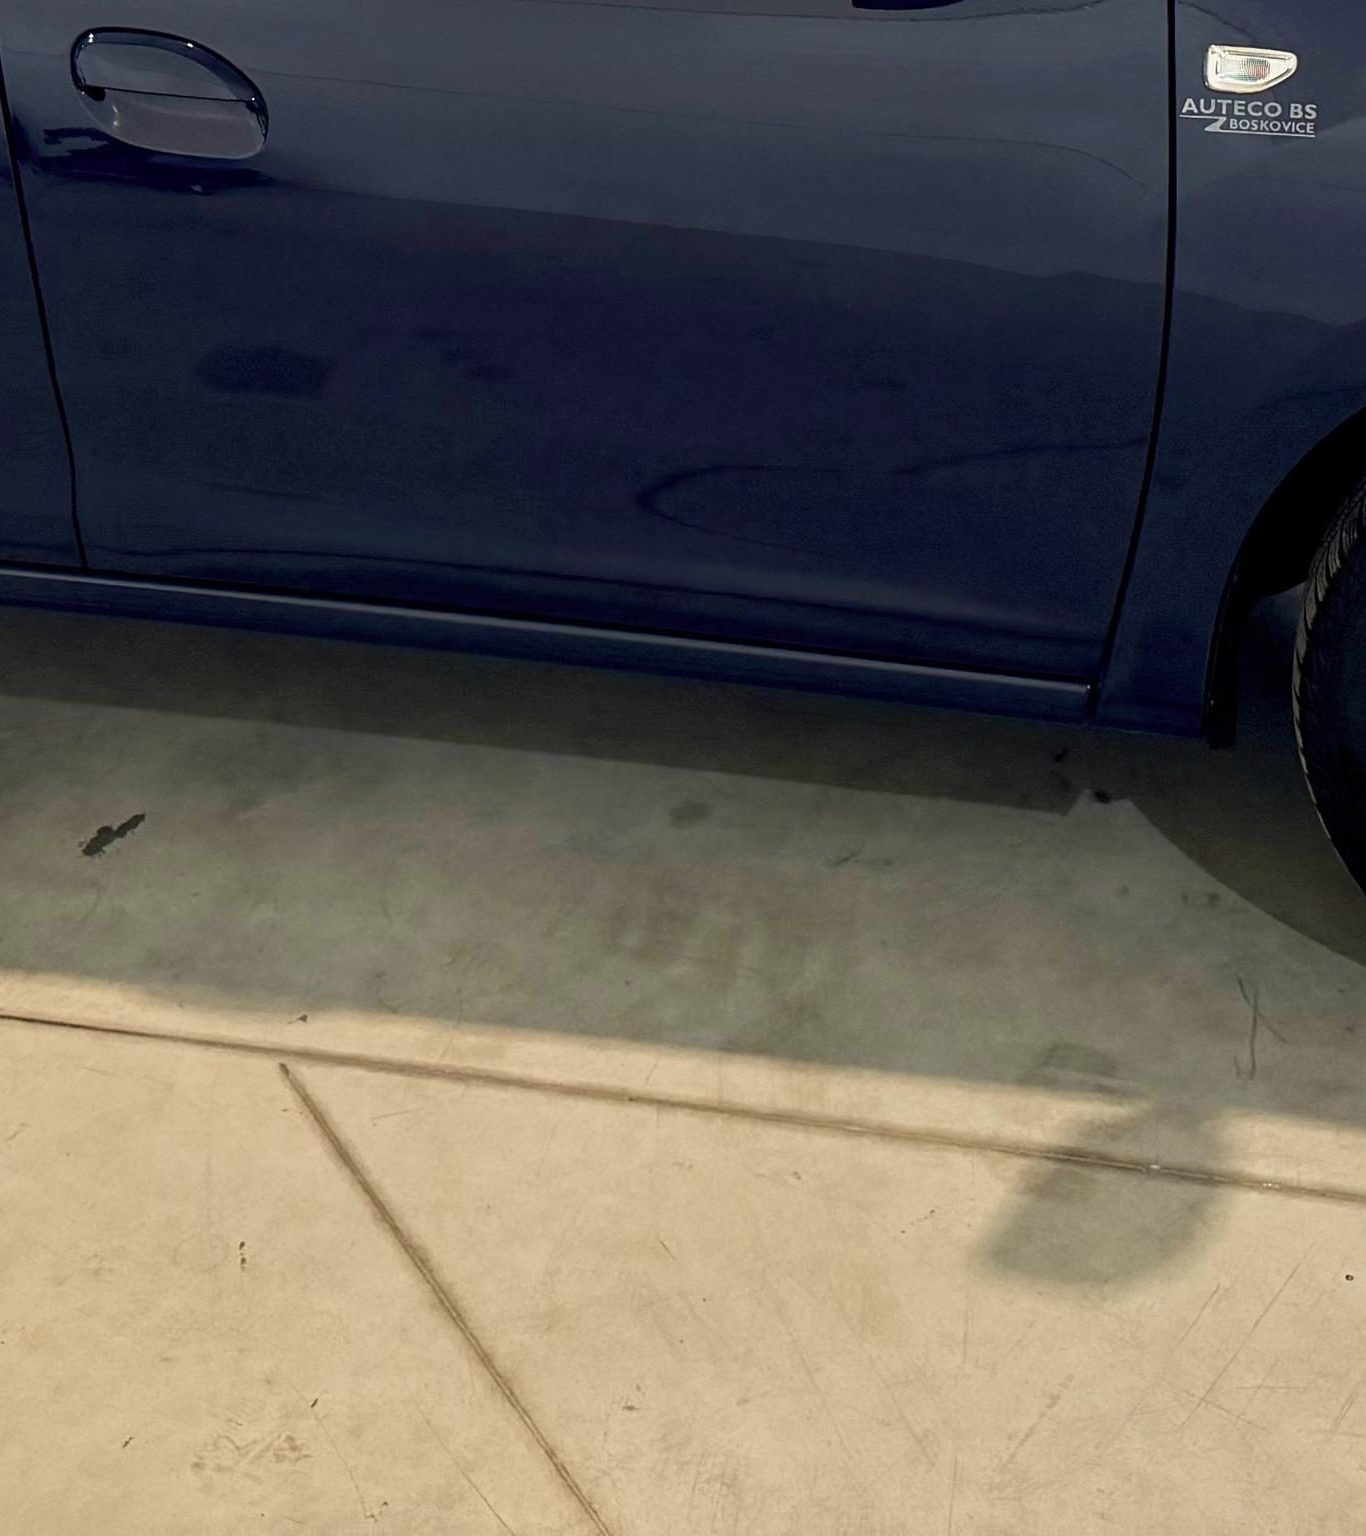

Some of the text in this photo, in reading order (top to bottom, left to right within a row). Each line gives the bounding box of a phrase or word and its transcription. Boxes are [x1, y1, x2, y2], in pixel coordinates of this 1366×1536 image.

[1182, 97, 1317, 120] AUTECO BS
[1229, 118, 1315, 134] BOSKOVICE
